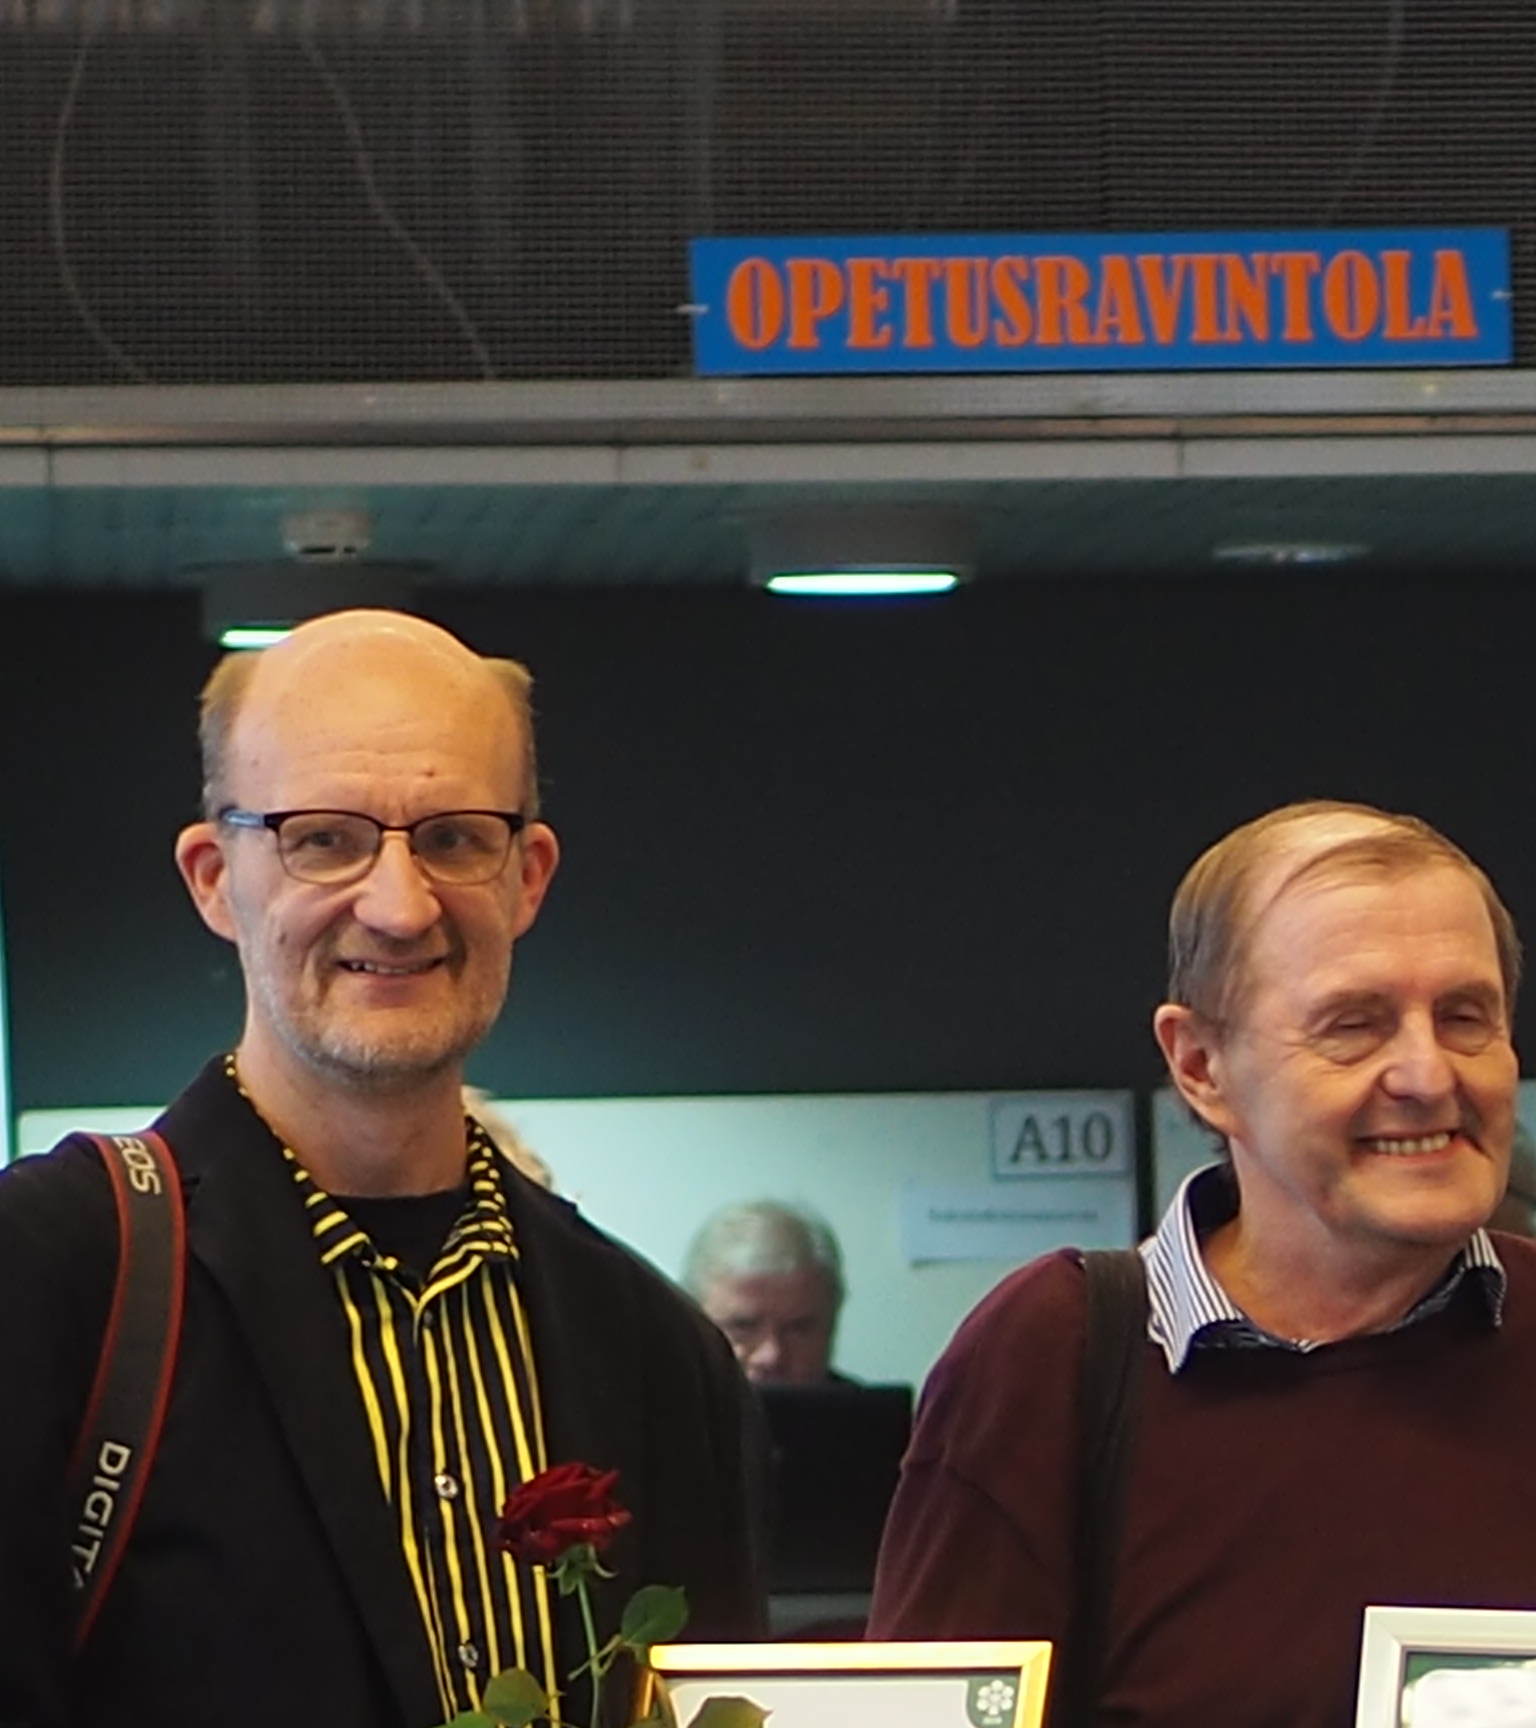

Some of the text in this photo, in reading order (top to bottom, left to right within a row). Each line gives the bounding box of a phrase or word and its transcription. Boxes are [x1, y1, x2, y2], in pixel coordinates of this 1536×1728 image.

[725, 249, 1477, 351] OPETUSRAVINTOLA
[111, 1136, 162, 1195] EOS
[1009, 1110, 1114, 1165] A10
